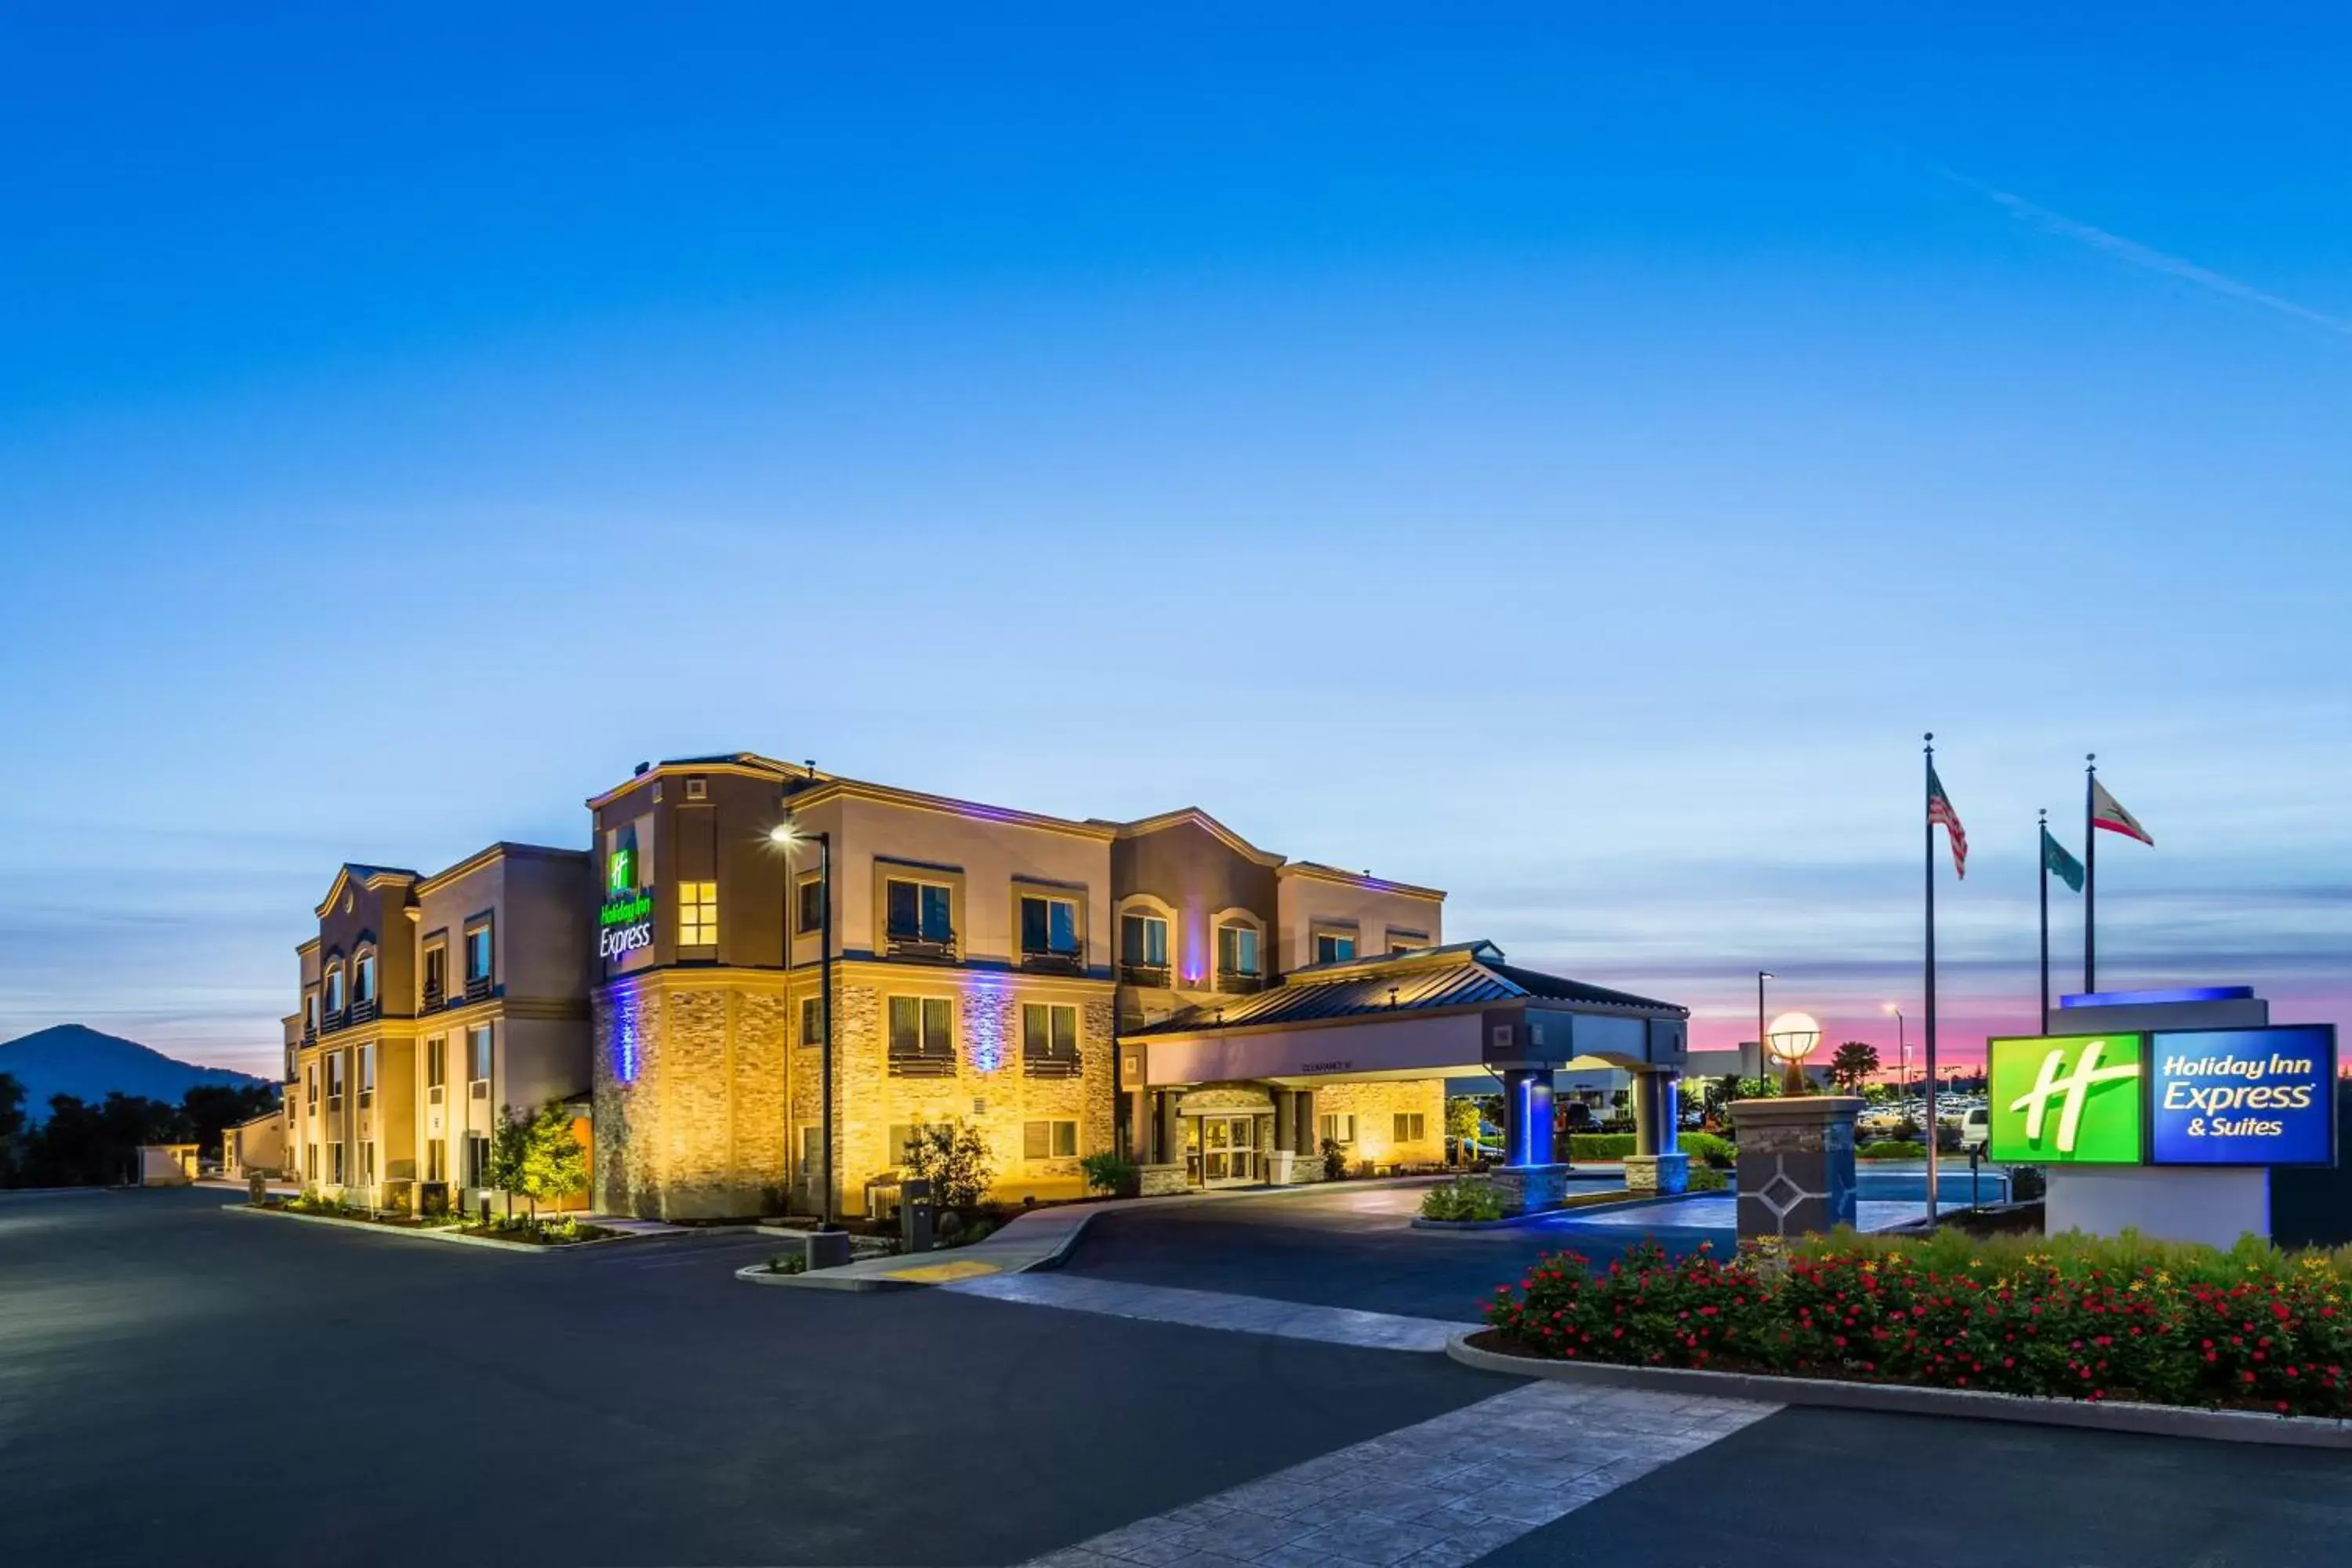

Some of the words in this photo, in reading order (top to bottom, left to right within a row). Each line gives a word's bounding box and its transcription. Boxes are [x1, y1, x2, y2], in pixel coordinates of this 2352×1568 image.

[601, 900, 636, 925] Holiday
[635, 895, 651, 916] Inn
[600, 923, 650, 962] Express
[2162, 1054, 2266, 1080] Holiday
[2269, 1054, 2313, 1075] Inn
[2163, 1081, 2313, 1116] Express
[2187, 1118, 2206, 1137] &
[2209, 1118, 2284, 1137] Suites
